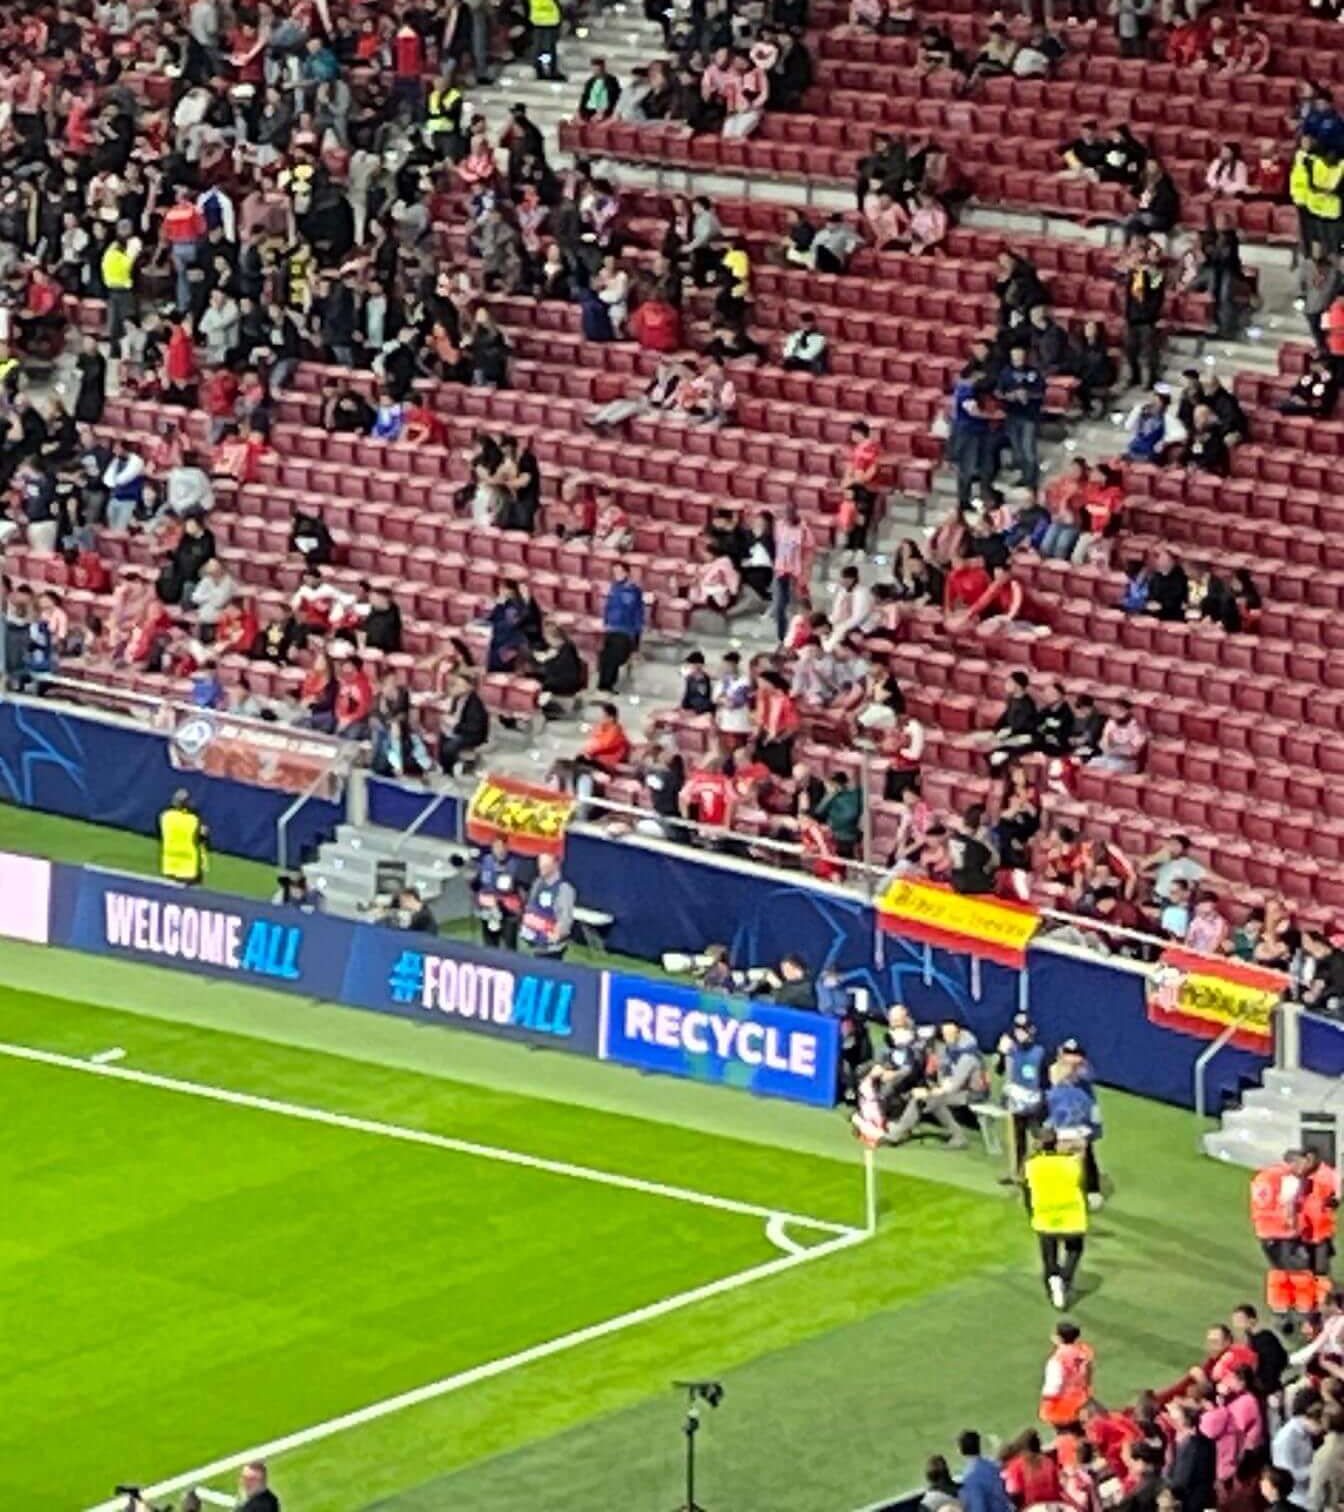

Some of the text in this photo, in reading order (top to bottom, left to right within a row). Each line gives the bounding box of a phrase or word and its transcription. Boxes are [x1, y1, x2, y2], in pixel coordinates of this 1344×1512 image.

[105, 891, 301, 980] WELCOME ALL
[388, 951, 574, 1036] #FOOTBALL
[625, 998, 818, 1076] RECYCLE
